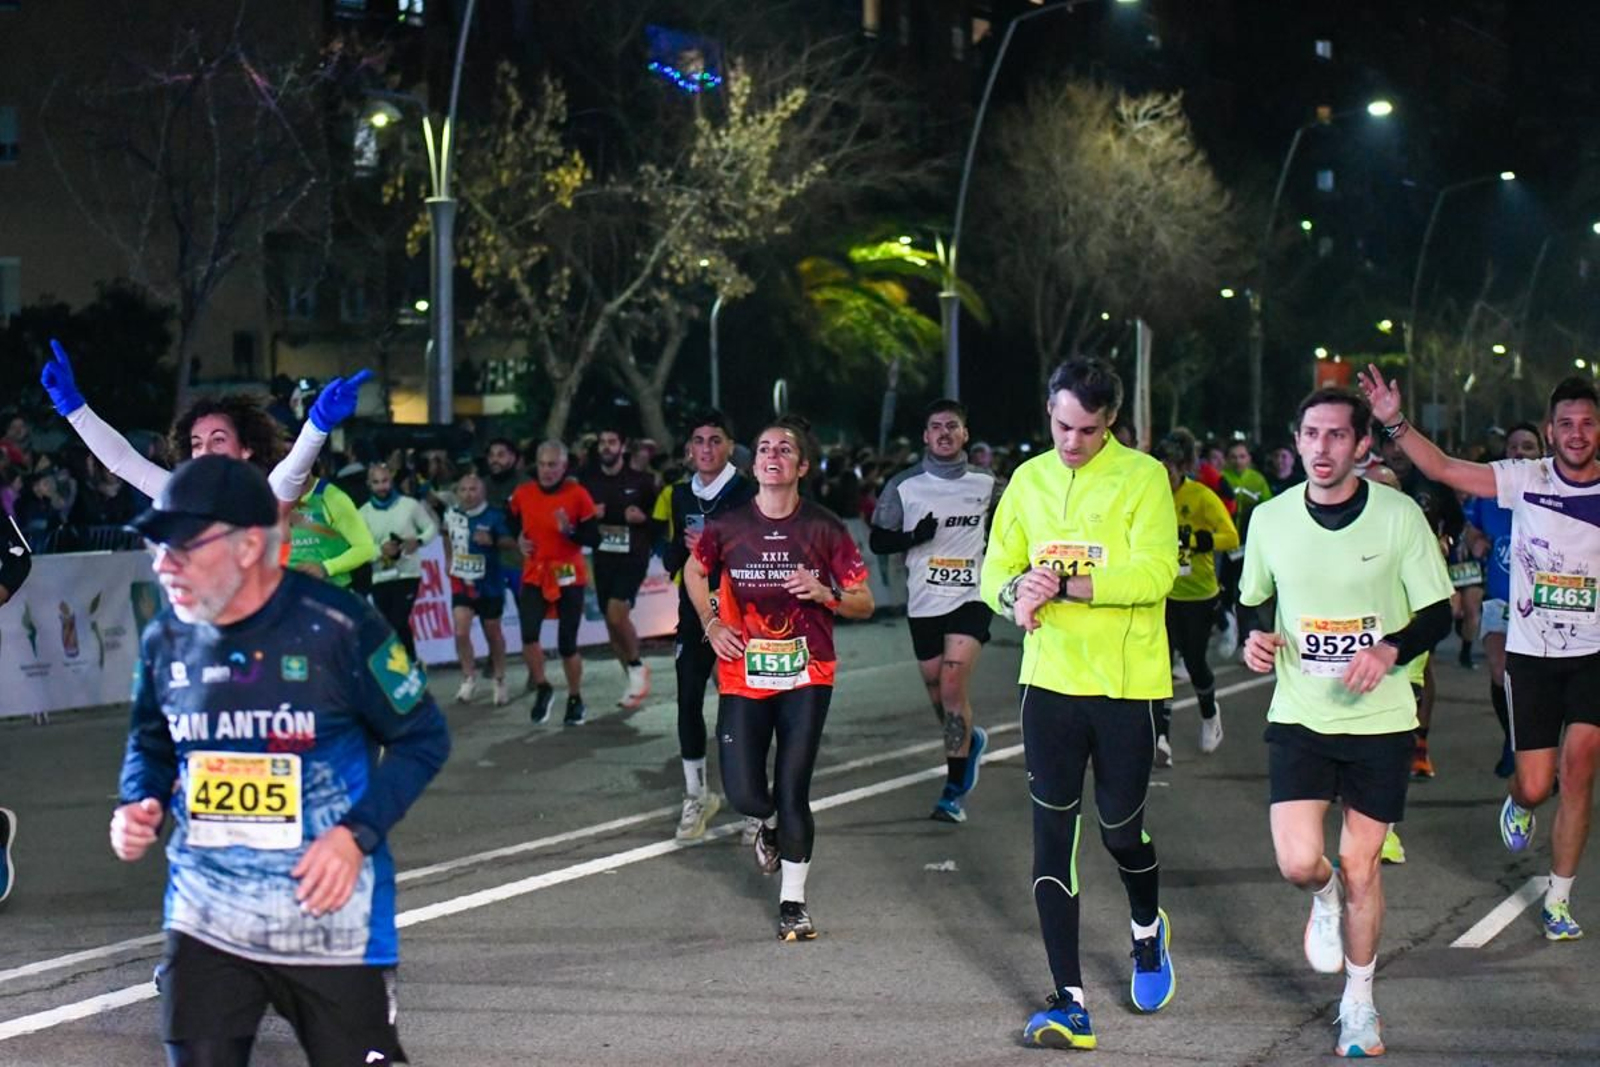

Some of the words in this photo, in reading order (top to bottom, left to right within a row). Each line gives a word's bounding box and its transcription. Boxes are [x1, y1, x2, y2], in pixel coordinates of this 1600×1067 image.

[761, 551, 790, 562] XXIX
[730, 568, 766, 580] NUTRIAS
[928, 567, 973, 582] 7923
[1537, 585, 1592, 606] 1463
[1305, 632, 1375, 656] 9529
[751, 651, 805, 671] 1514
[215, 703, 316, 741] ANTÓN
[194, 780, 287, 812] 4205
